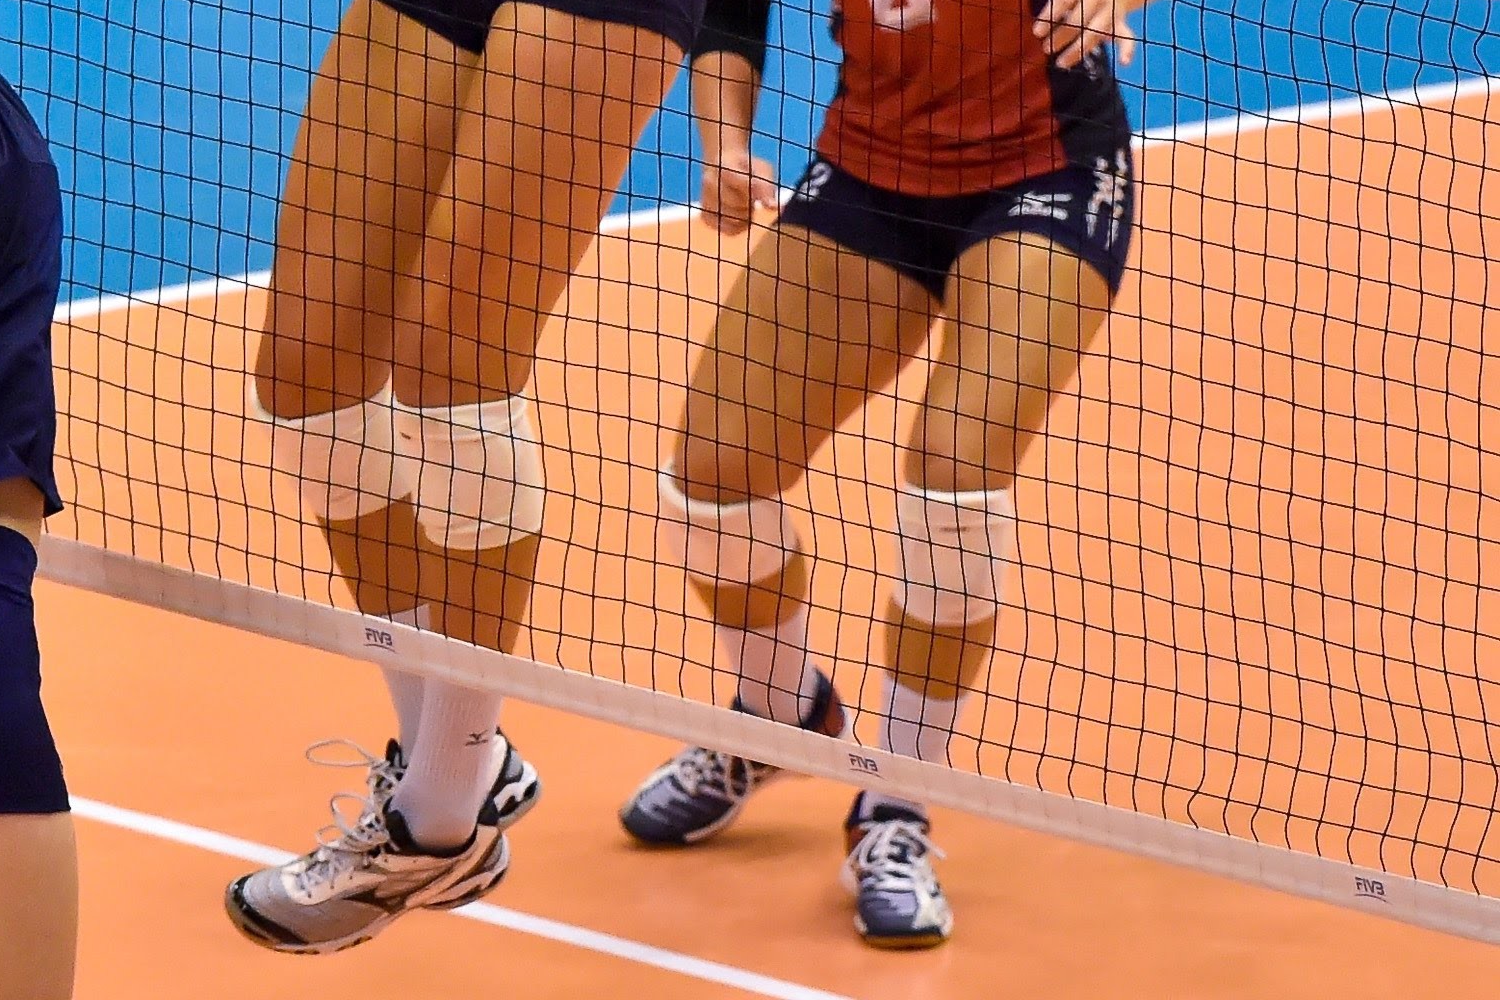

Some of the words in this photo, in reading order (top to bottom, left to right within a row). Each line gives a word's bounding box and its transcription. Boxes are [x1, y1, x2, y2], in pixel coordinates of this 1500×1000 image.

[364, 627, 393, 647] FIVB
[848, 753, 878, 772] FIVB
[1355, 876, 1385, 896] FIVB
